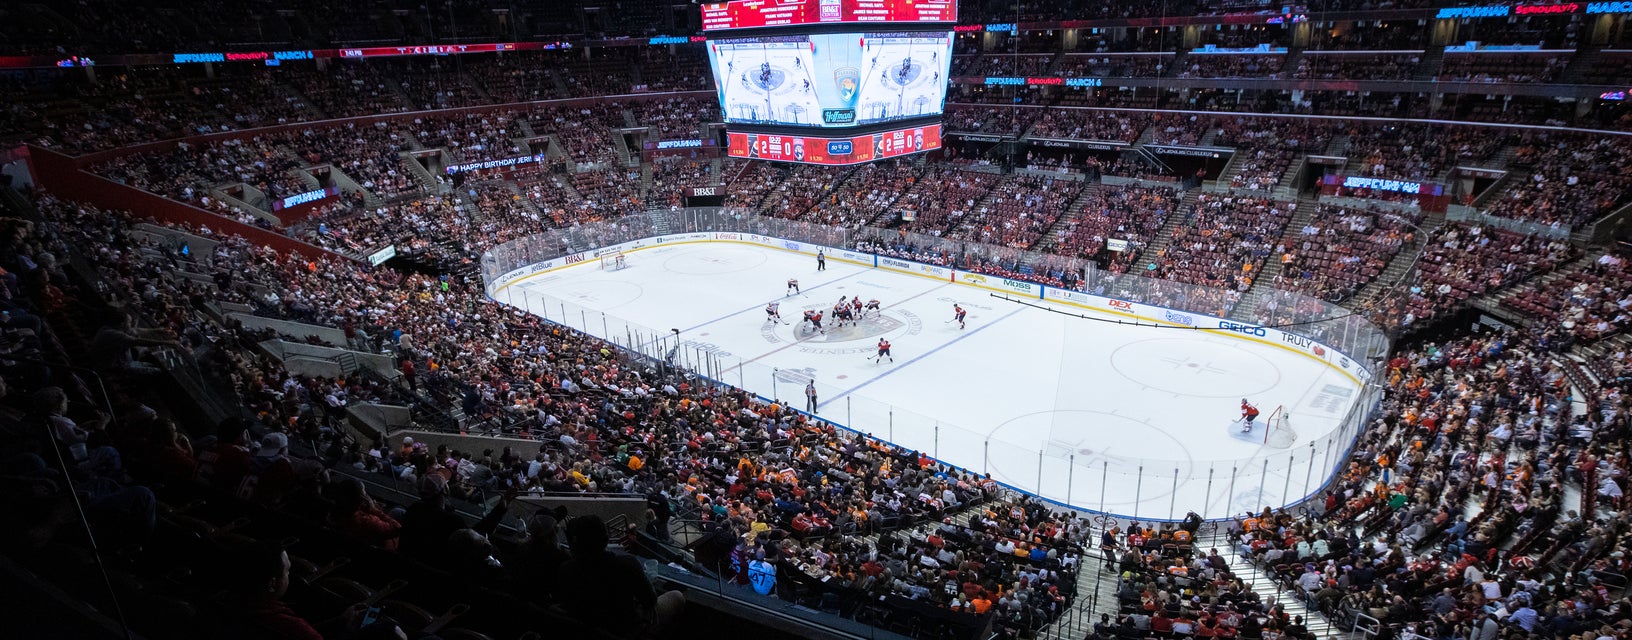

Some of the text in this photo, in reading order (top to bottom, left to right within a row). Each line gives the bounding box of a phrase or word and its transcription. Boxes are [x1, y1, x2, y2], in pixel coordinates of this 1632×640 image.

[1586, 1, 1632, 14] MARC
[986, 24, 1009, 32] MARCH
[1010, 23, 1017, 31] 6
[274, 51, 306, 60] MARCH
[307, 50, 313, 59] 6
[1066, 78, 1093, 86] MARCH
[762, 141, 768, 154] 2
[785, 142, 791, 155] 0
[887, 139, 892, 151] 2
[907, 135, 912, 148] 0
[460, 163, 483, 172] HAPPY
[484, 158, 516, 168] BIRTHDAY
[693, 187, 717, 196] BB&T
[565, 253, 585, 265] BB&T
[531, 262, 552, 273] jetBlue
[1108, 299, 1132, 309] DEX
[1219, 321, 1265, 337] GEICO
[1282, 332, 1313, 349] TRULY
[752, 573, 766, 586] 47
